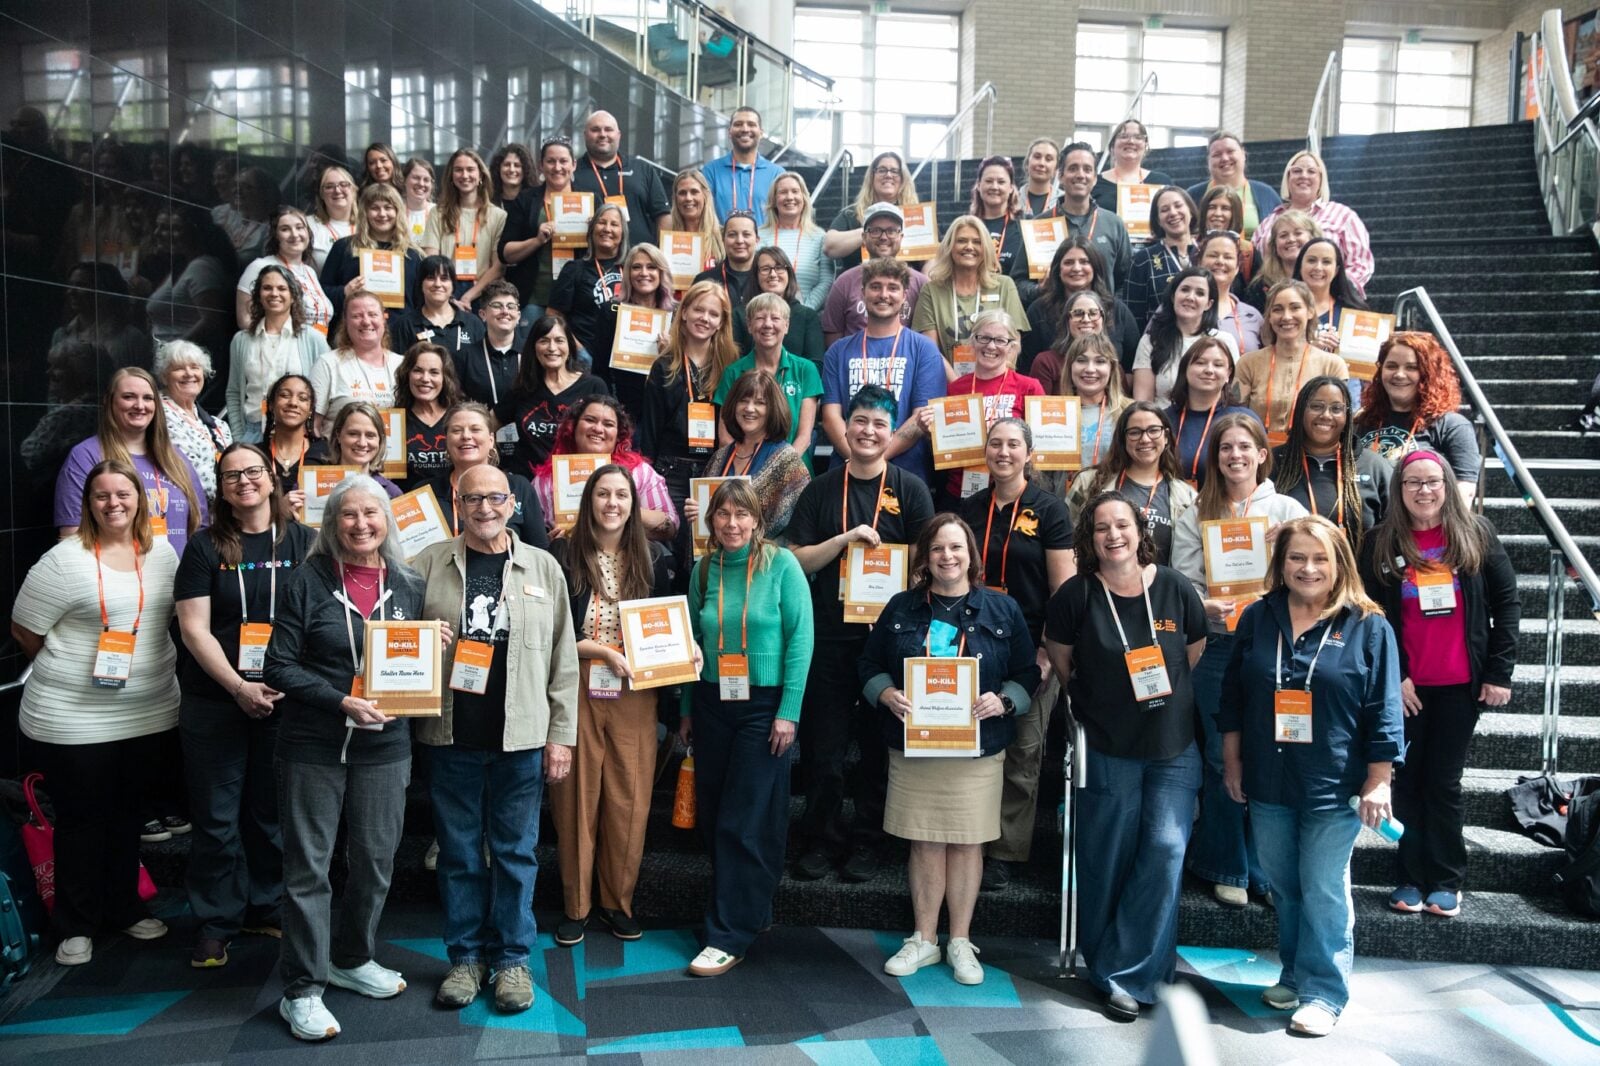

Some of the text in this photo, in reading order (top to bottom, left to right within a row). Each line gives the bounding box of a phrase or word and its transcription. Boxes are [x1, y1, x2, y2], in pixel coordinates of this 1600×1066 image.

[848, 357, 908, 370] GRENBRER
[527, 421, 560, 434] AST
[408, 451, 450, 464] ASTR
[1146, 514, 1173, 527] UTUA
[864, 559, 890, 567] NO-KILL
[642, 620, 670, 630] NO-KILL
